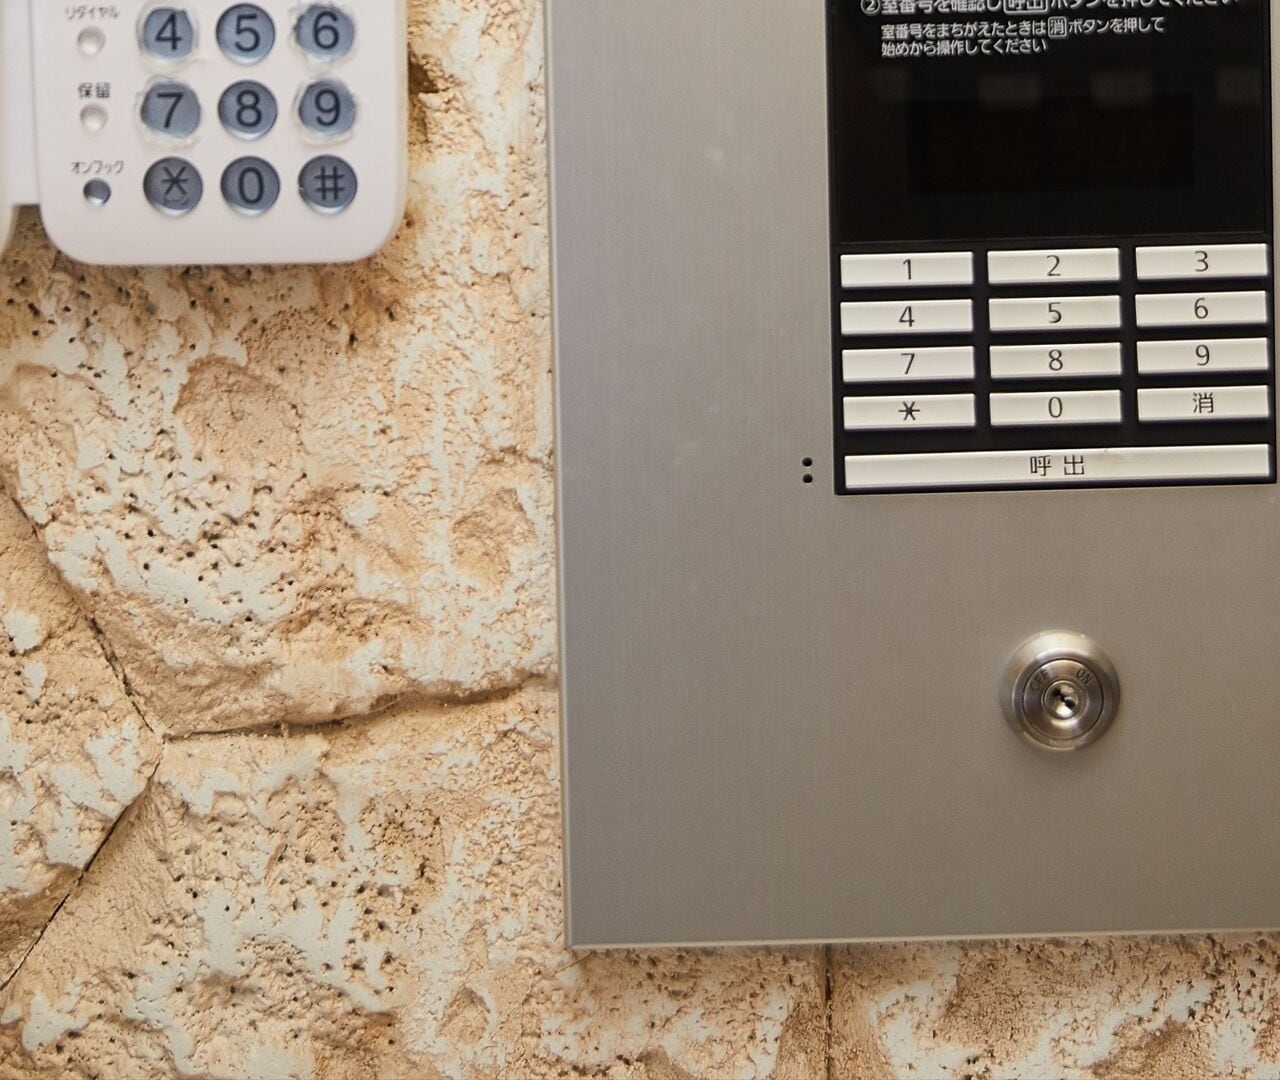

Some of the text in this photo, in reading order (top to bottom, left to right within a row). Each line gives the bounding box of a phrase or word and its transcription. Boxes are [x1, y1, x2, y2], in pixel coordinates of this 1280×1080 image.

[66, 6, 118, 19] リダイヤル
[154, 12, 341, 52] 4 5 6
[882, 40, 1046, 57] 始めから操作してください
[78, 83, 110, 98] 保留
[156, 90, 341, 130] 7 8 9
[72, 161, 123, 174] オンフック
[238, 166, 265, 205] 0
[903, 251, 1208, 280] 1 2 3
[899, 298, 1208, 327] 4 5 6
[901, 345, 1209, 374] 7 8 9
[1048, 397, 1063, 418] 0
[1193, 392, 1214, 413] 消
[1075, 668, 1095, 686] ON
